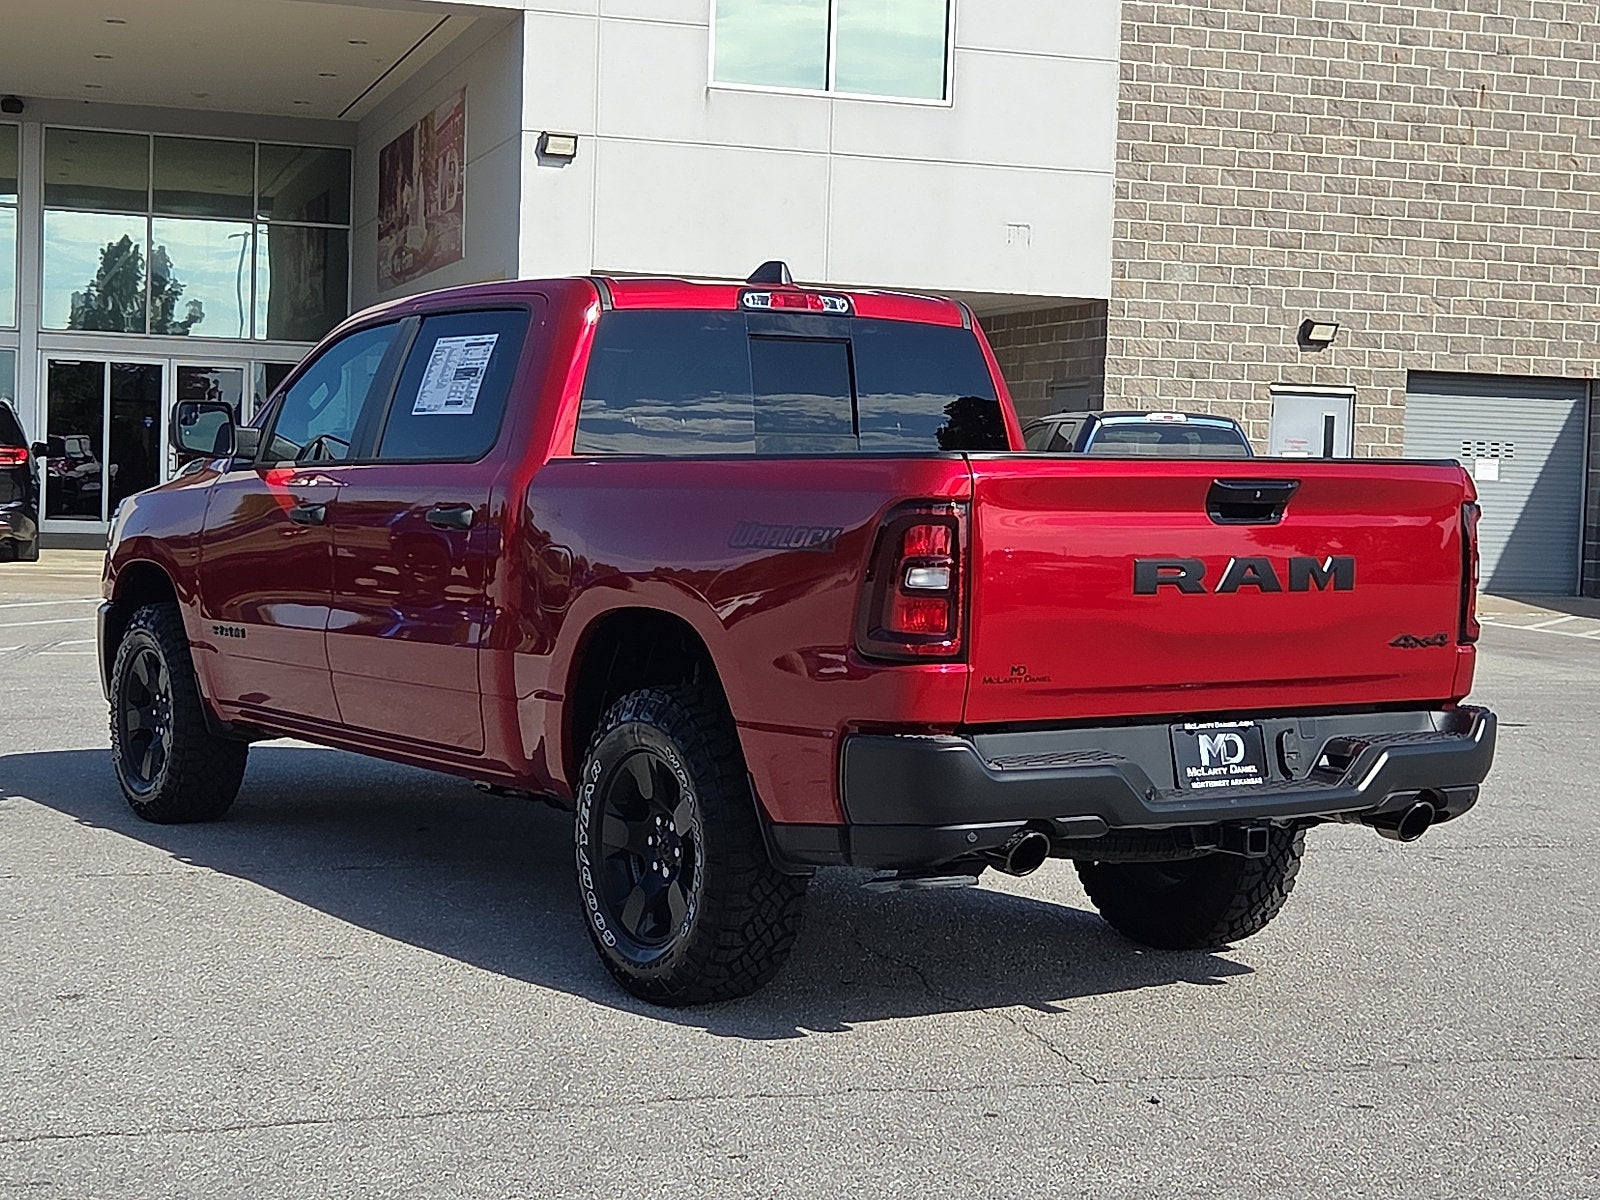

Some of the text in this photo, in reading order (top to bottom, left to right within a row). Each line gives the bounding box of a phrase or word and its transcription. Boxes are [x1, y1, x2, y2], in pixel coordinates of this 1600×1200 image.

[728, 520, 844, 551] WARLOCK
[1133, 556, 1355, 595] RAM
[1198, 733, 1245, 766] MD
[580, 759, 616, 947] GOODYEAR
